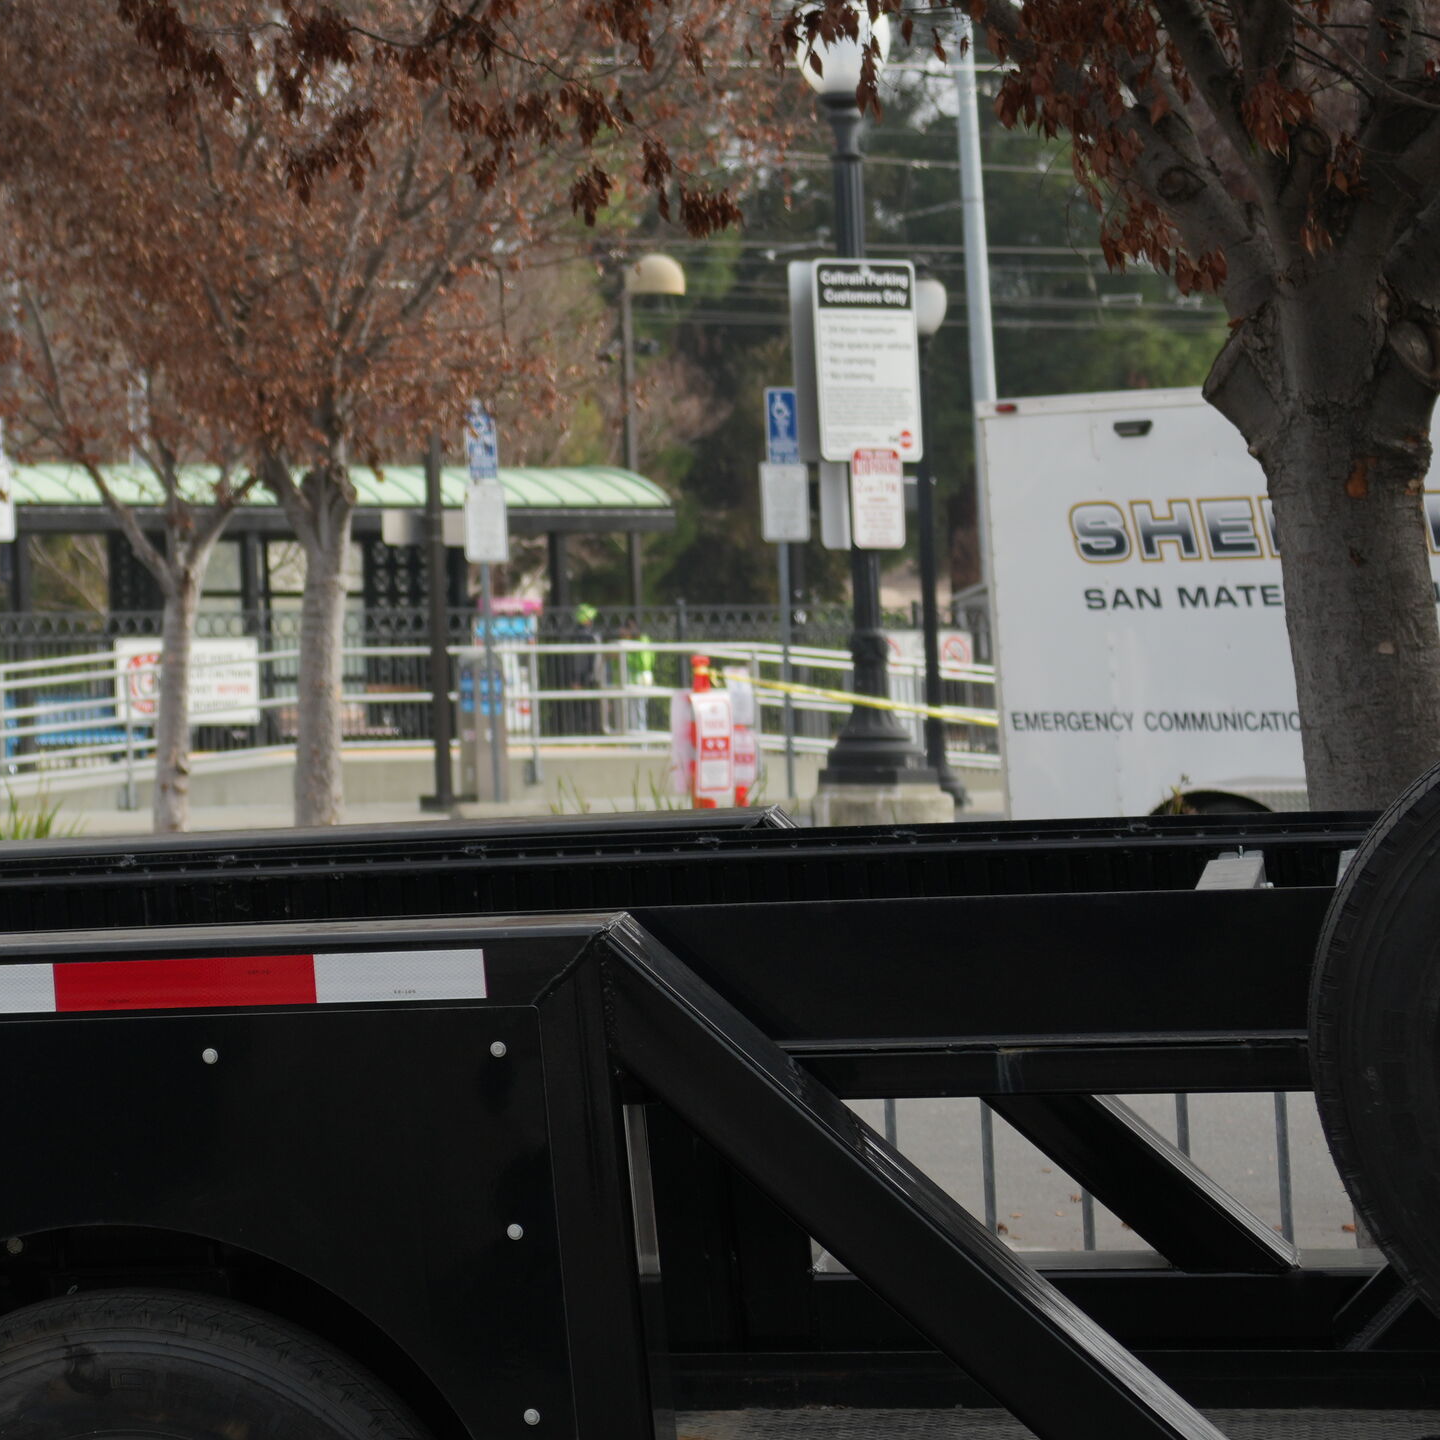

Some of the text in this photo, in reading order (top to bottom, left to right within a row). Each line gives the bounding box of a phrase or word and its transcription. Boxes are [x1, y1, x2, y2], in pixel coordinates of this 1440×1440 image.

[820, 270, 909, 289] Caltrain Parking
[823, 288, 908, 307] Customers Only
[1069, 496, 1282, 564] SHE
[1084, 584, 1284, 611] SAN MATE
[1012, 711, 1300, 732] EMERGENCY COMMUNICATIO
